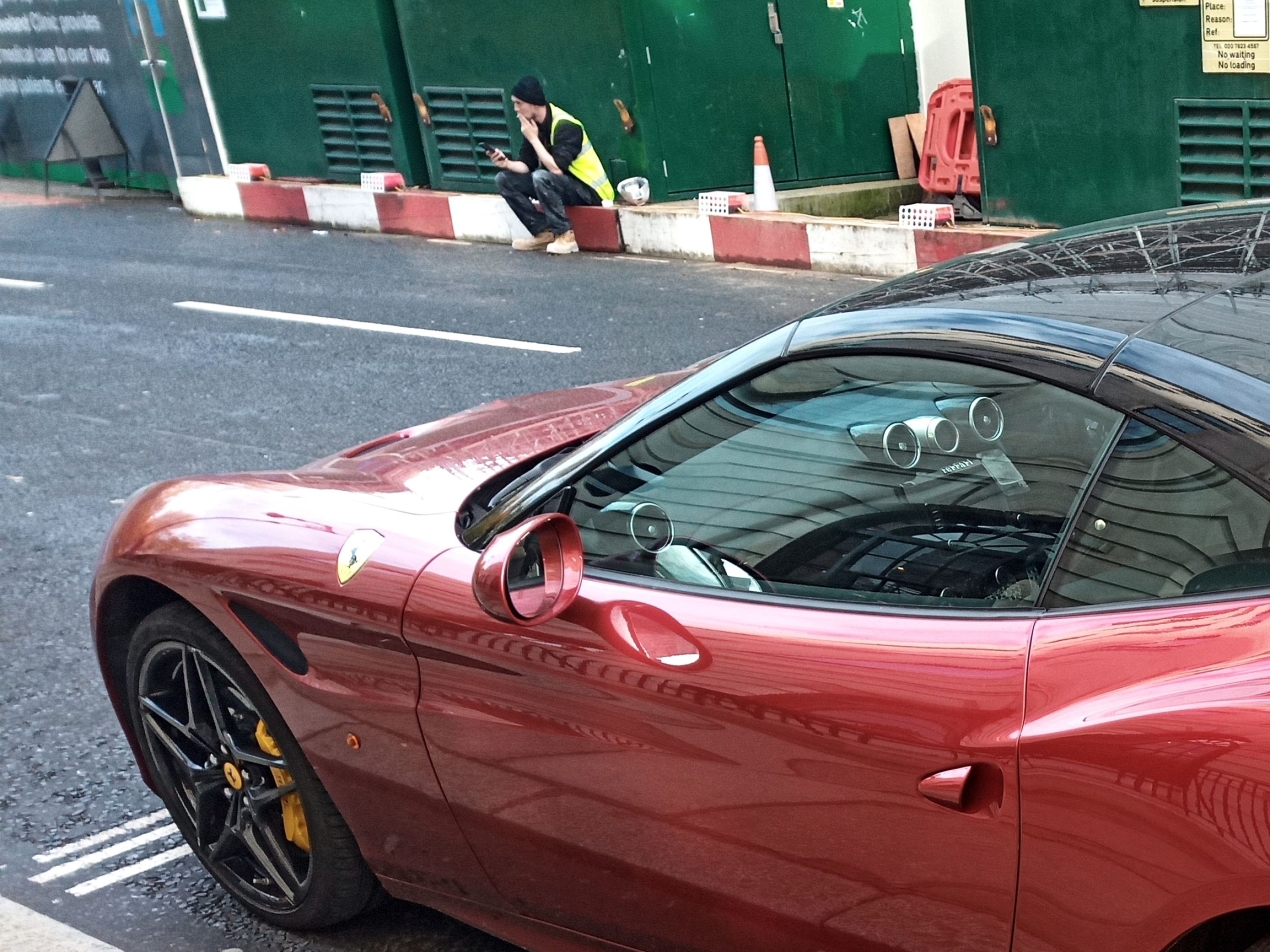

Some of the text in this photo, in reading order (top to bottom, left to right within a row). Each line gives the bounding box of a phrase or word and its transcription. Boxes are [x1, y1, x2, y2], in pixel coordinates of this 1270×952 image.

[1205, 14, 1233, 24] Reason:
[1206, 27, 1220, 36] Ref:
[54, 45, 67, 62] to
[67, 47, 88, 62] over
[88, 45, 110, 63] two
[1218, 50, 1256, 60] No waiting
[1218, 61, 1255, 70] No loading
